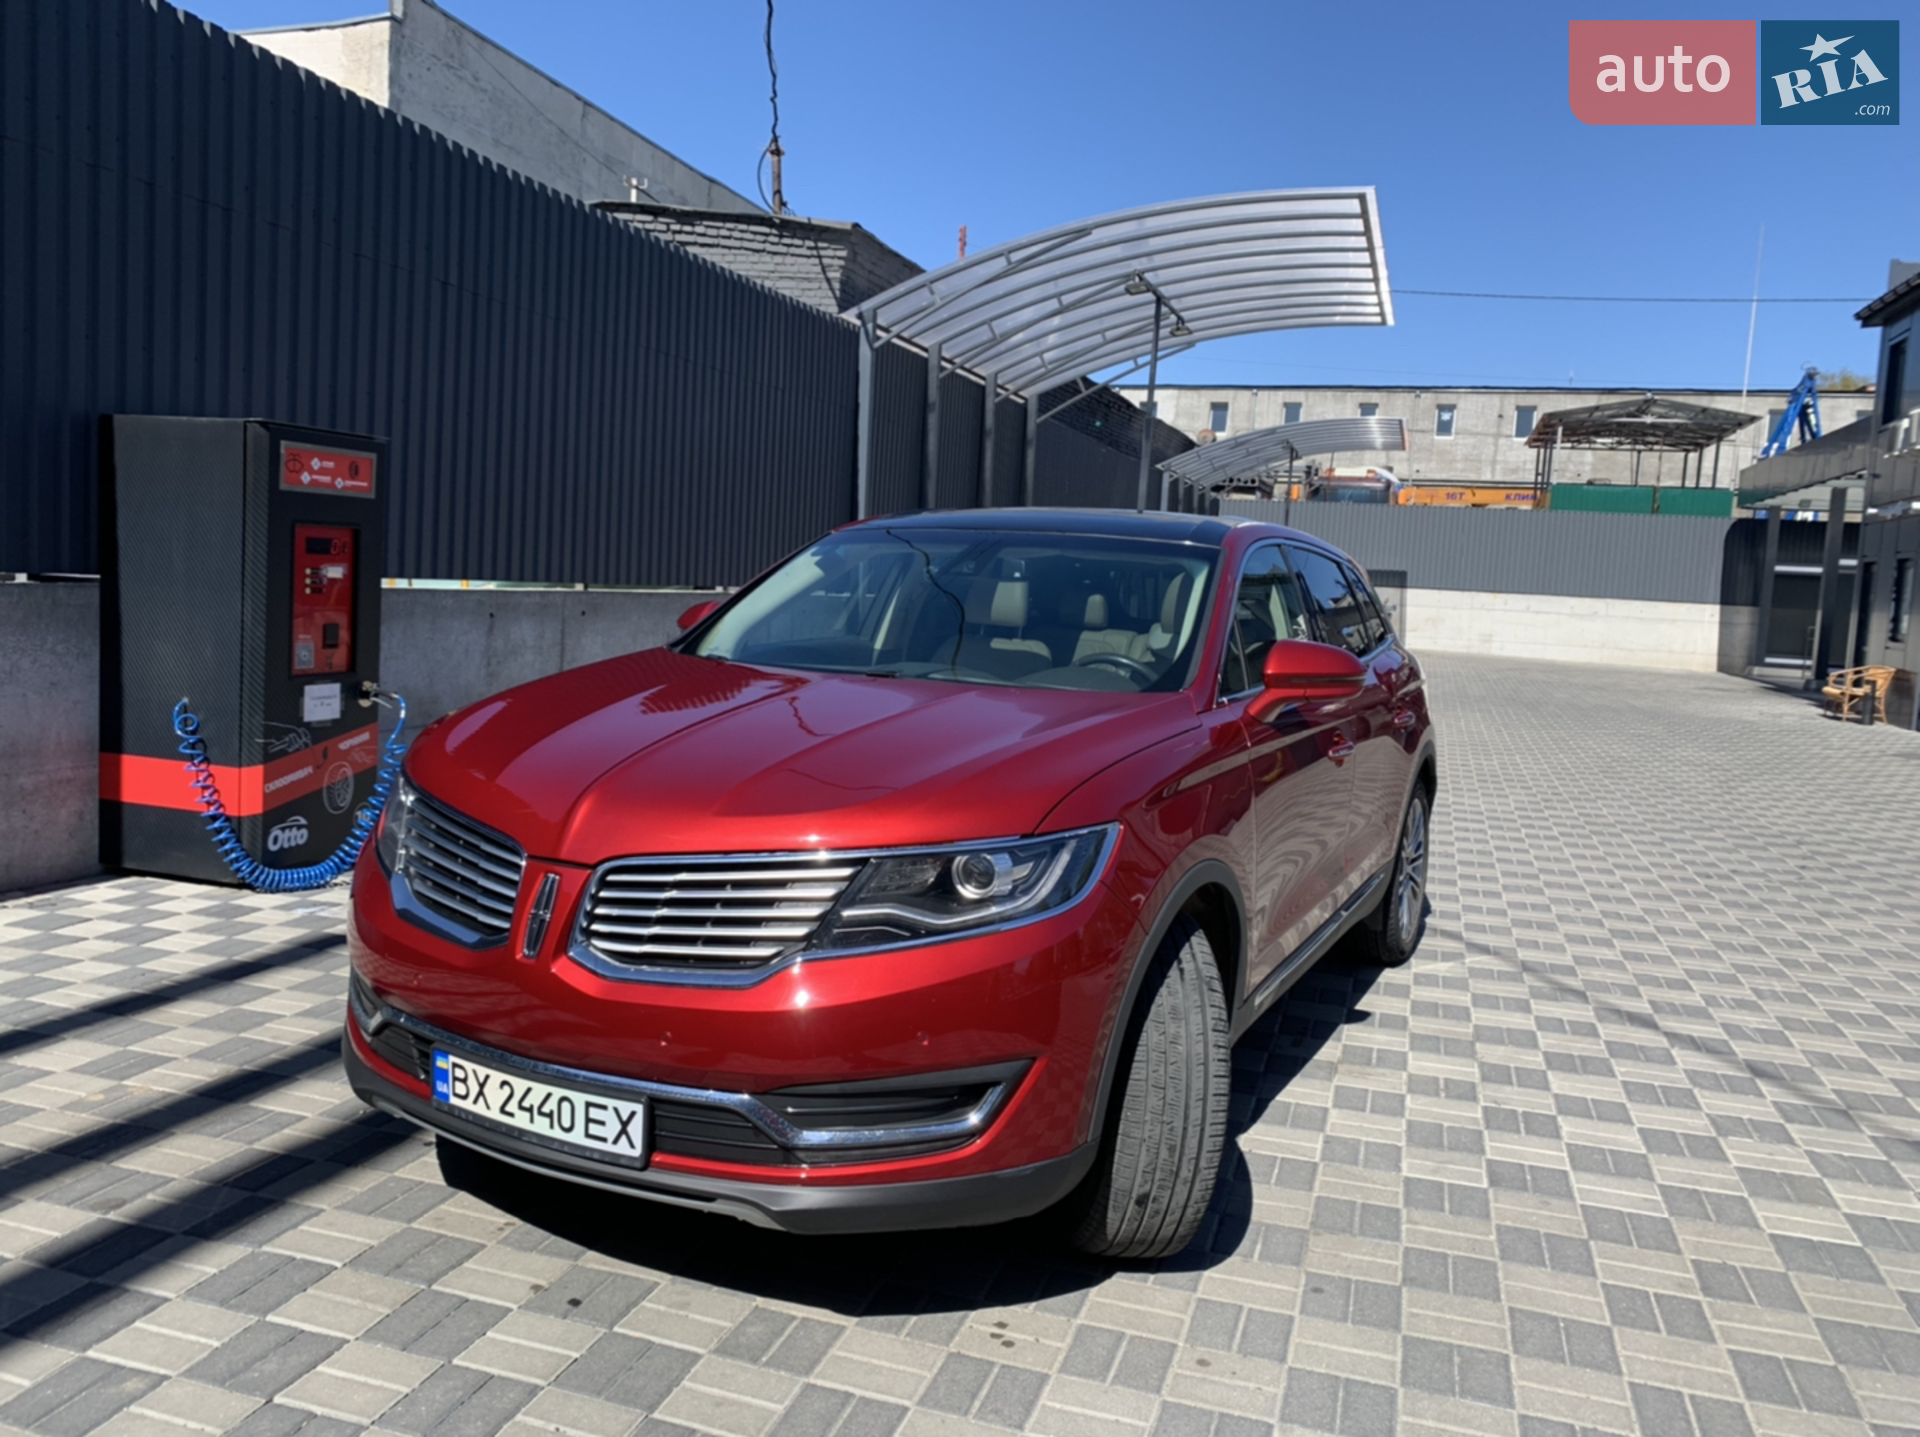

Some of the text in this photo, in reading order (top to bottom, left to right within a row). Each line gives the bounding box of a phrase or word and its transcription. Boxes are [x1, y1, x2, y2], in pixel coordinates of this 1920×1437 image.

[267, 826, 309, 852] Otto
[451, 1061, 491, 1111] BX
[499, 1079, 576, 1134] 2440
[584, 1100, 638, 1150] EX
